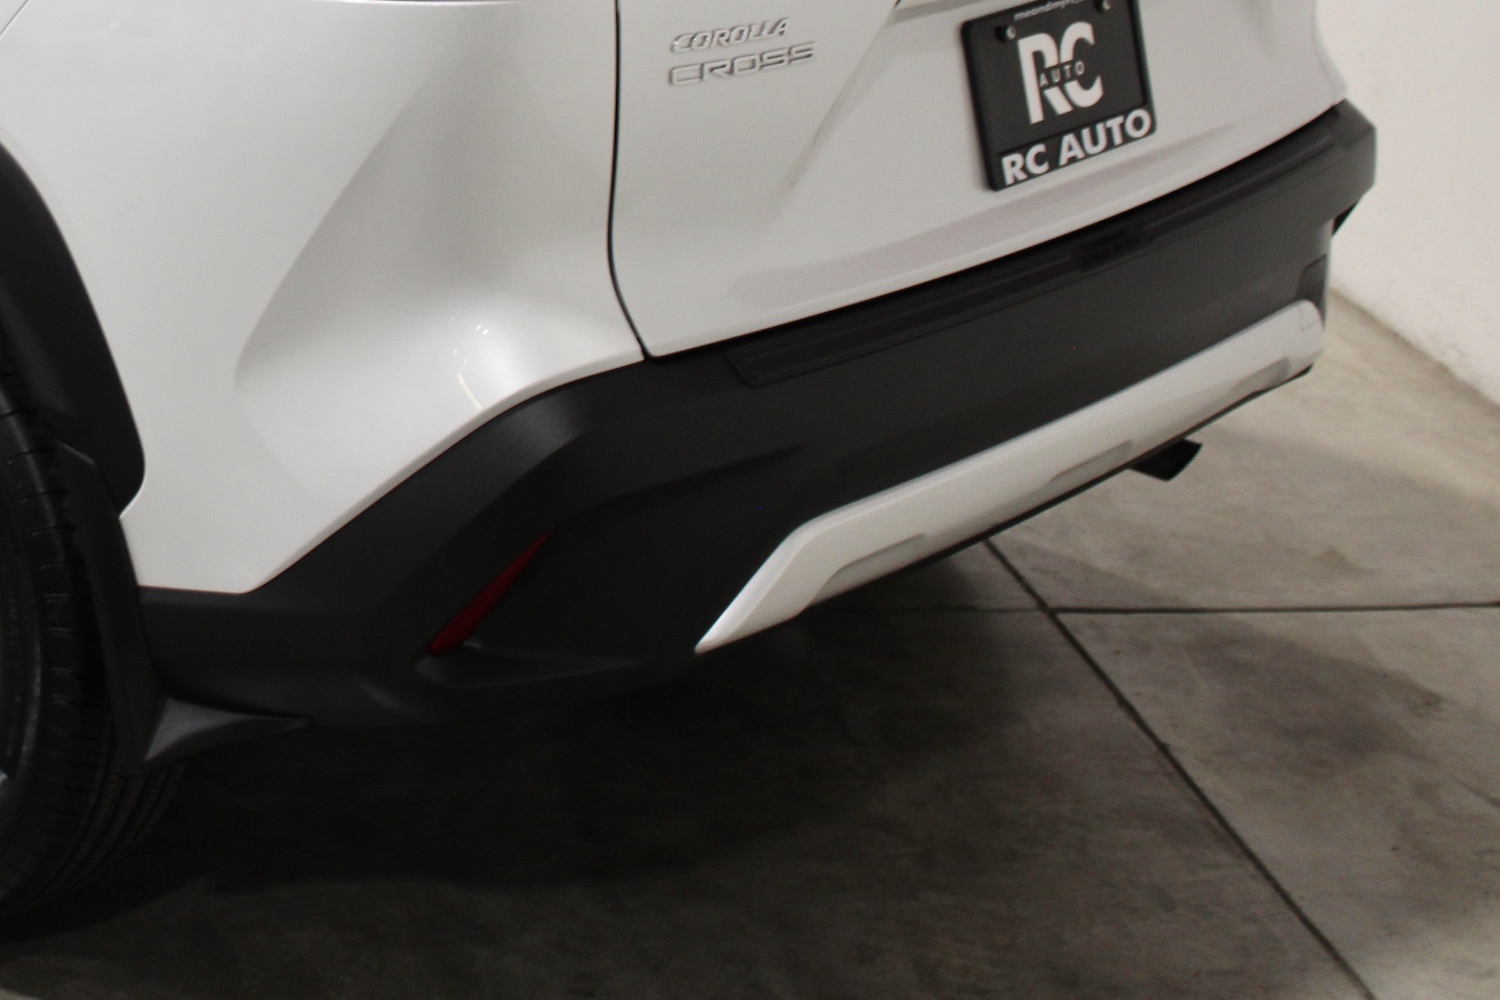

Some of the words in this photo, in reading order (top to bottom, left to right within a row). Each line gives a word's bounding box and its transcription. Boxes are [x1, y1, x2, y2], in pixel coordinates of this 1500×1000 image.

[670, 16, 790, 53] COROLLA
[668, 40, 817, 86] CROSS
[1017, 20, 1105, 126] RC
[1040, 60, 1086, 88] AUTO
[1001, 142, 1050, 187] RC
[1057, 107, 1153, 167] AUTO
